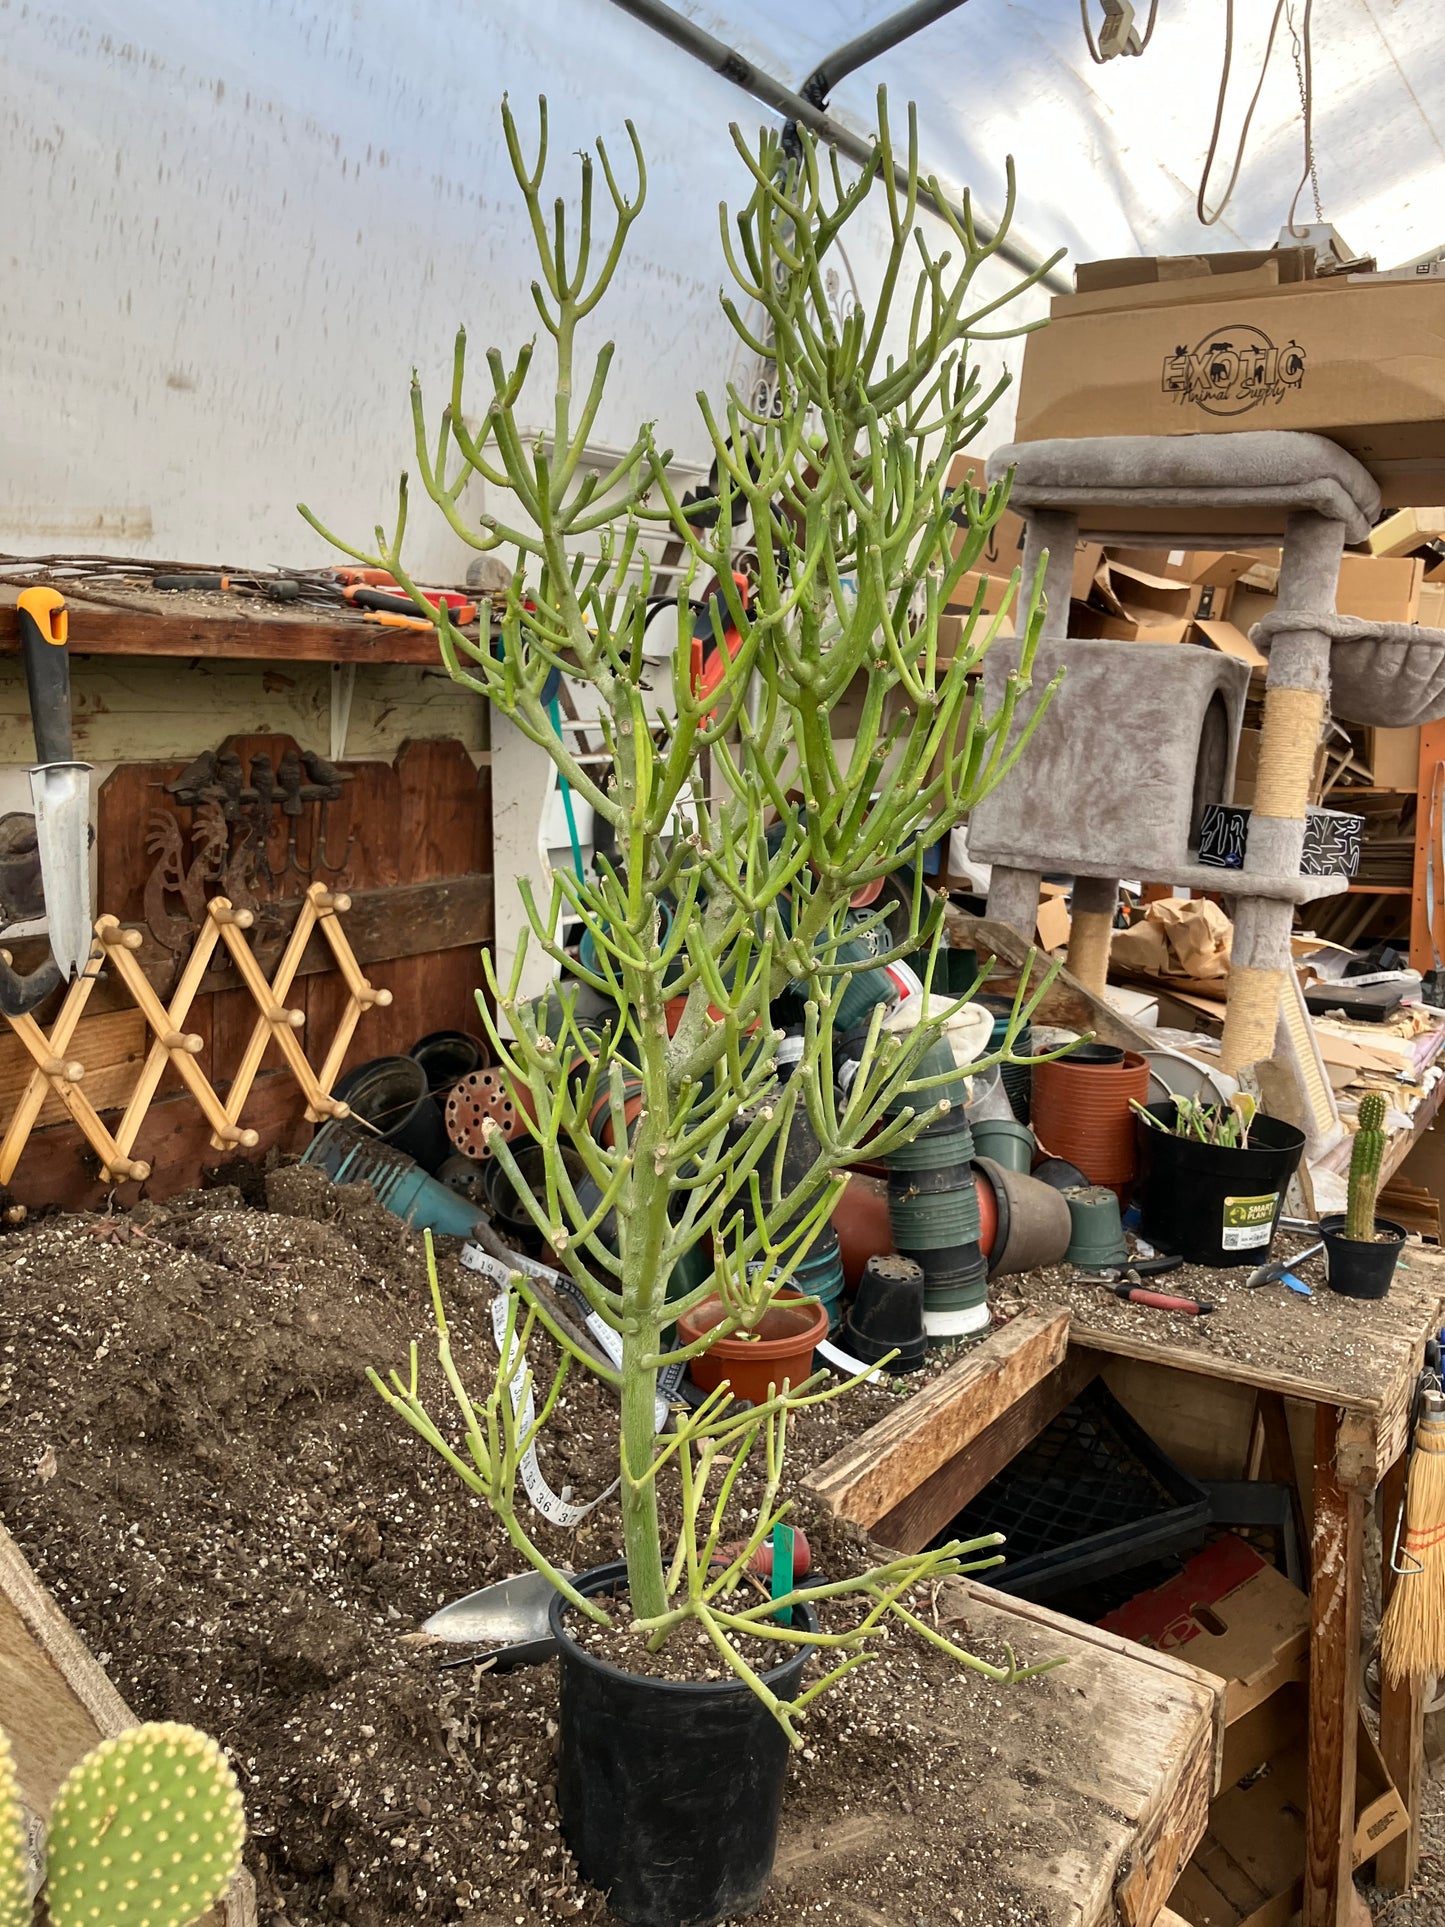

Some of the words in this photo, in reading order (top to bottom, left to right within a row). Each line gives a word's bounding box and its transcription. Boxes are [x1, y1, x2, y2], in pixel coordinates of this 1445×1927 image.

[1162, 345, 1307, 393] EXOTIC
[1172, 381, 1232, 405] Animal
[1235, 377, 1287, 406] Supply
[1247, 1210, 1273, 1220] PLANT
[1249, 1202, 1274, 1213] SMART
[480, 1260, 494, 1273] 19
[535, 1491, 552, 1512] 36
[557, 1511, 579, 1523] 37
